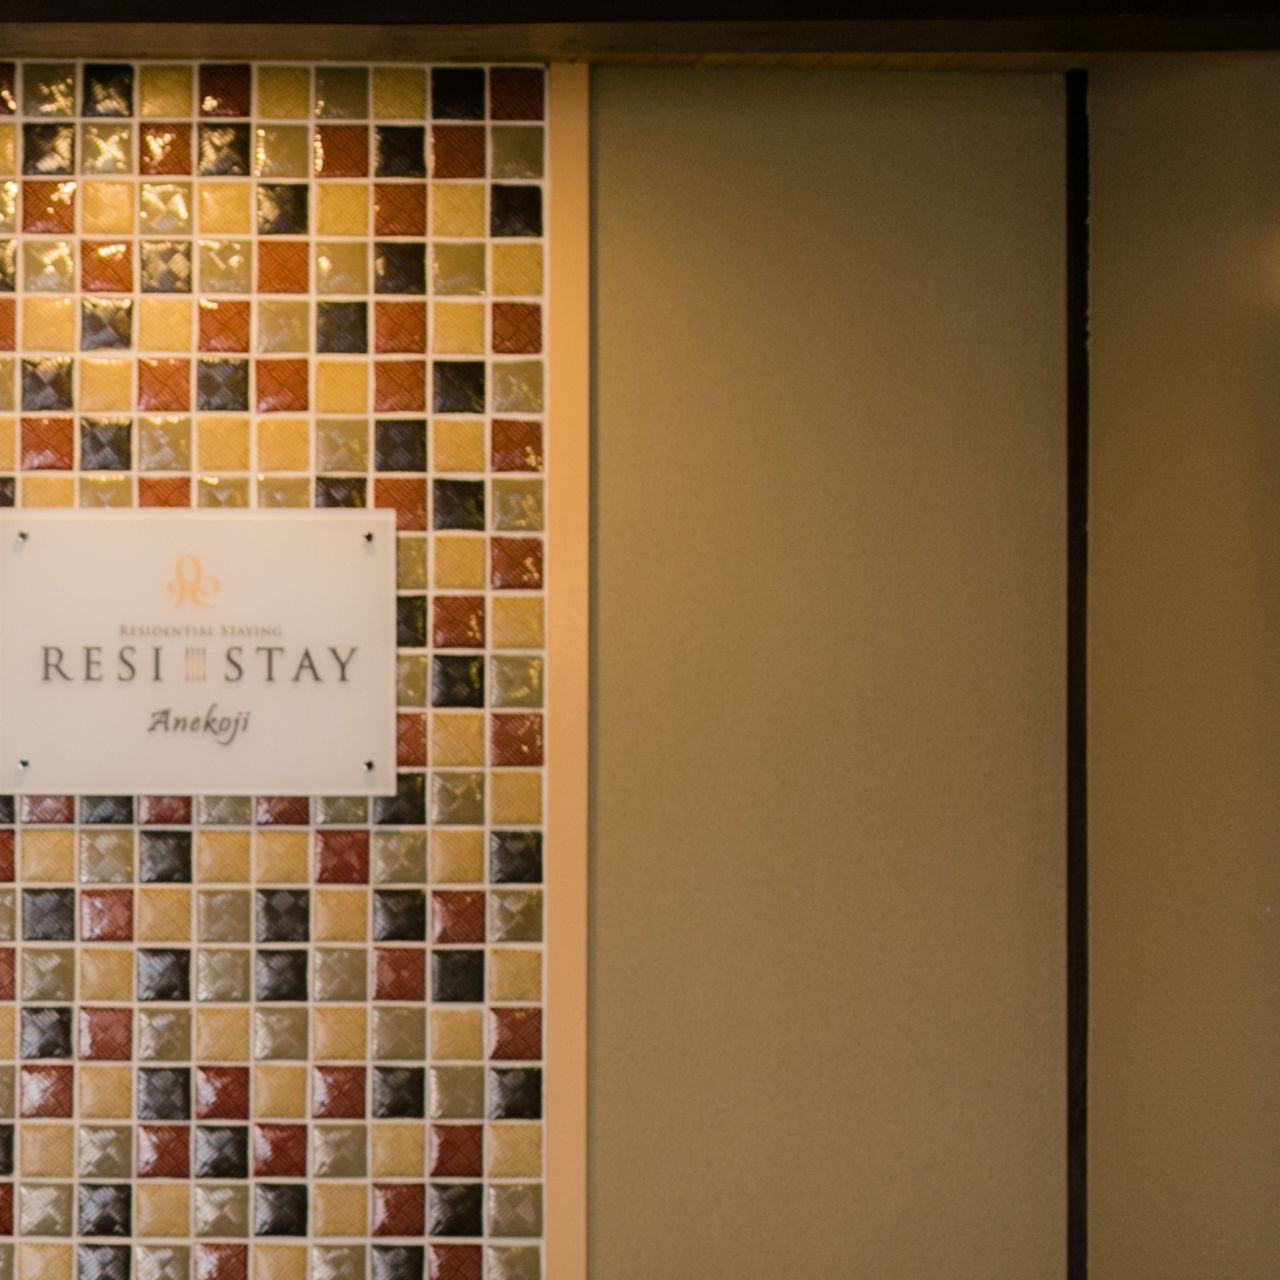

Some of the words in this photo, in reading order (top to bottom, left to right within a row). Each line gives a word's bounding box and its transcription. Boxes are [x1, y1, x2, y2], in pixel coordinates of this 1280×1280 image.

[119, 624, 213, 637] RESIDENTIAL
[221, 624, 283, 637] STAYING
[41, 646, 163, 682] RESI
[224, 646, 359, 682] STAY
[146, 703, 251, 745] Anekoji
